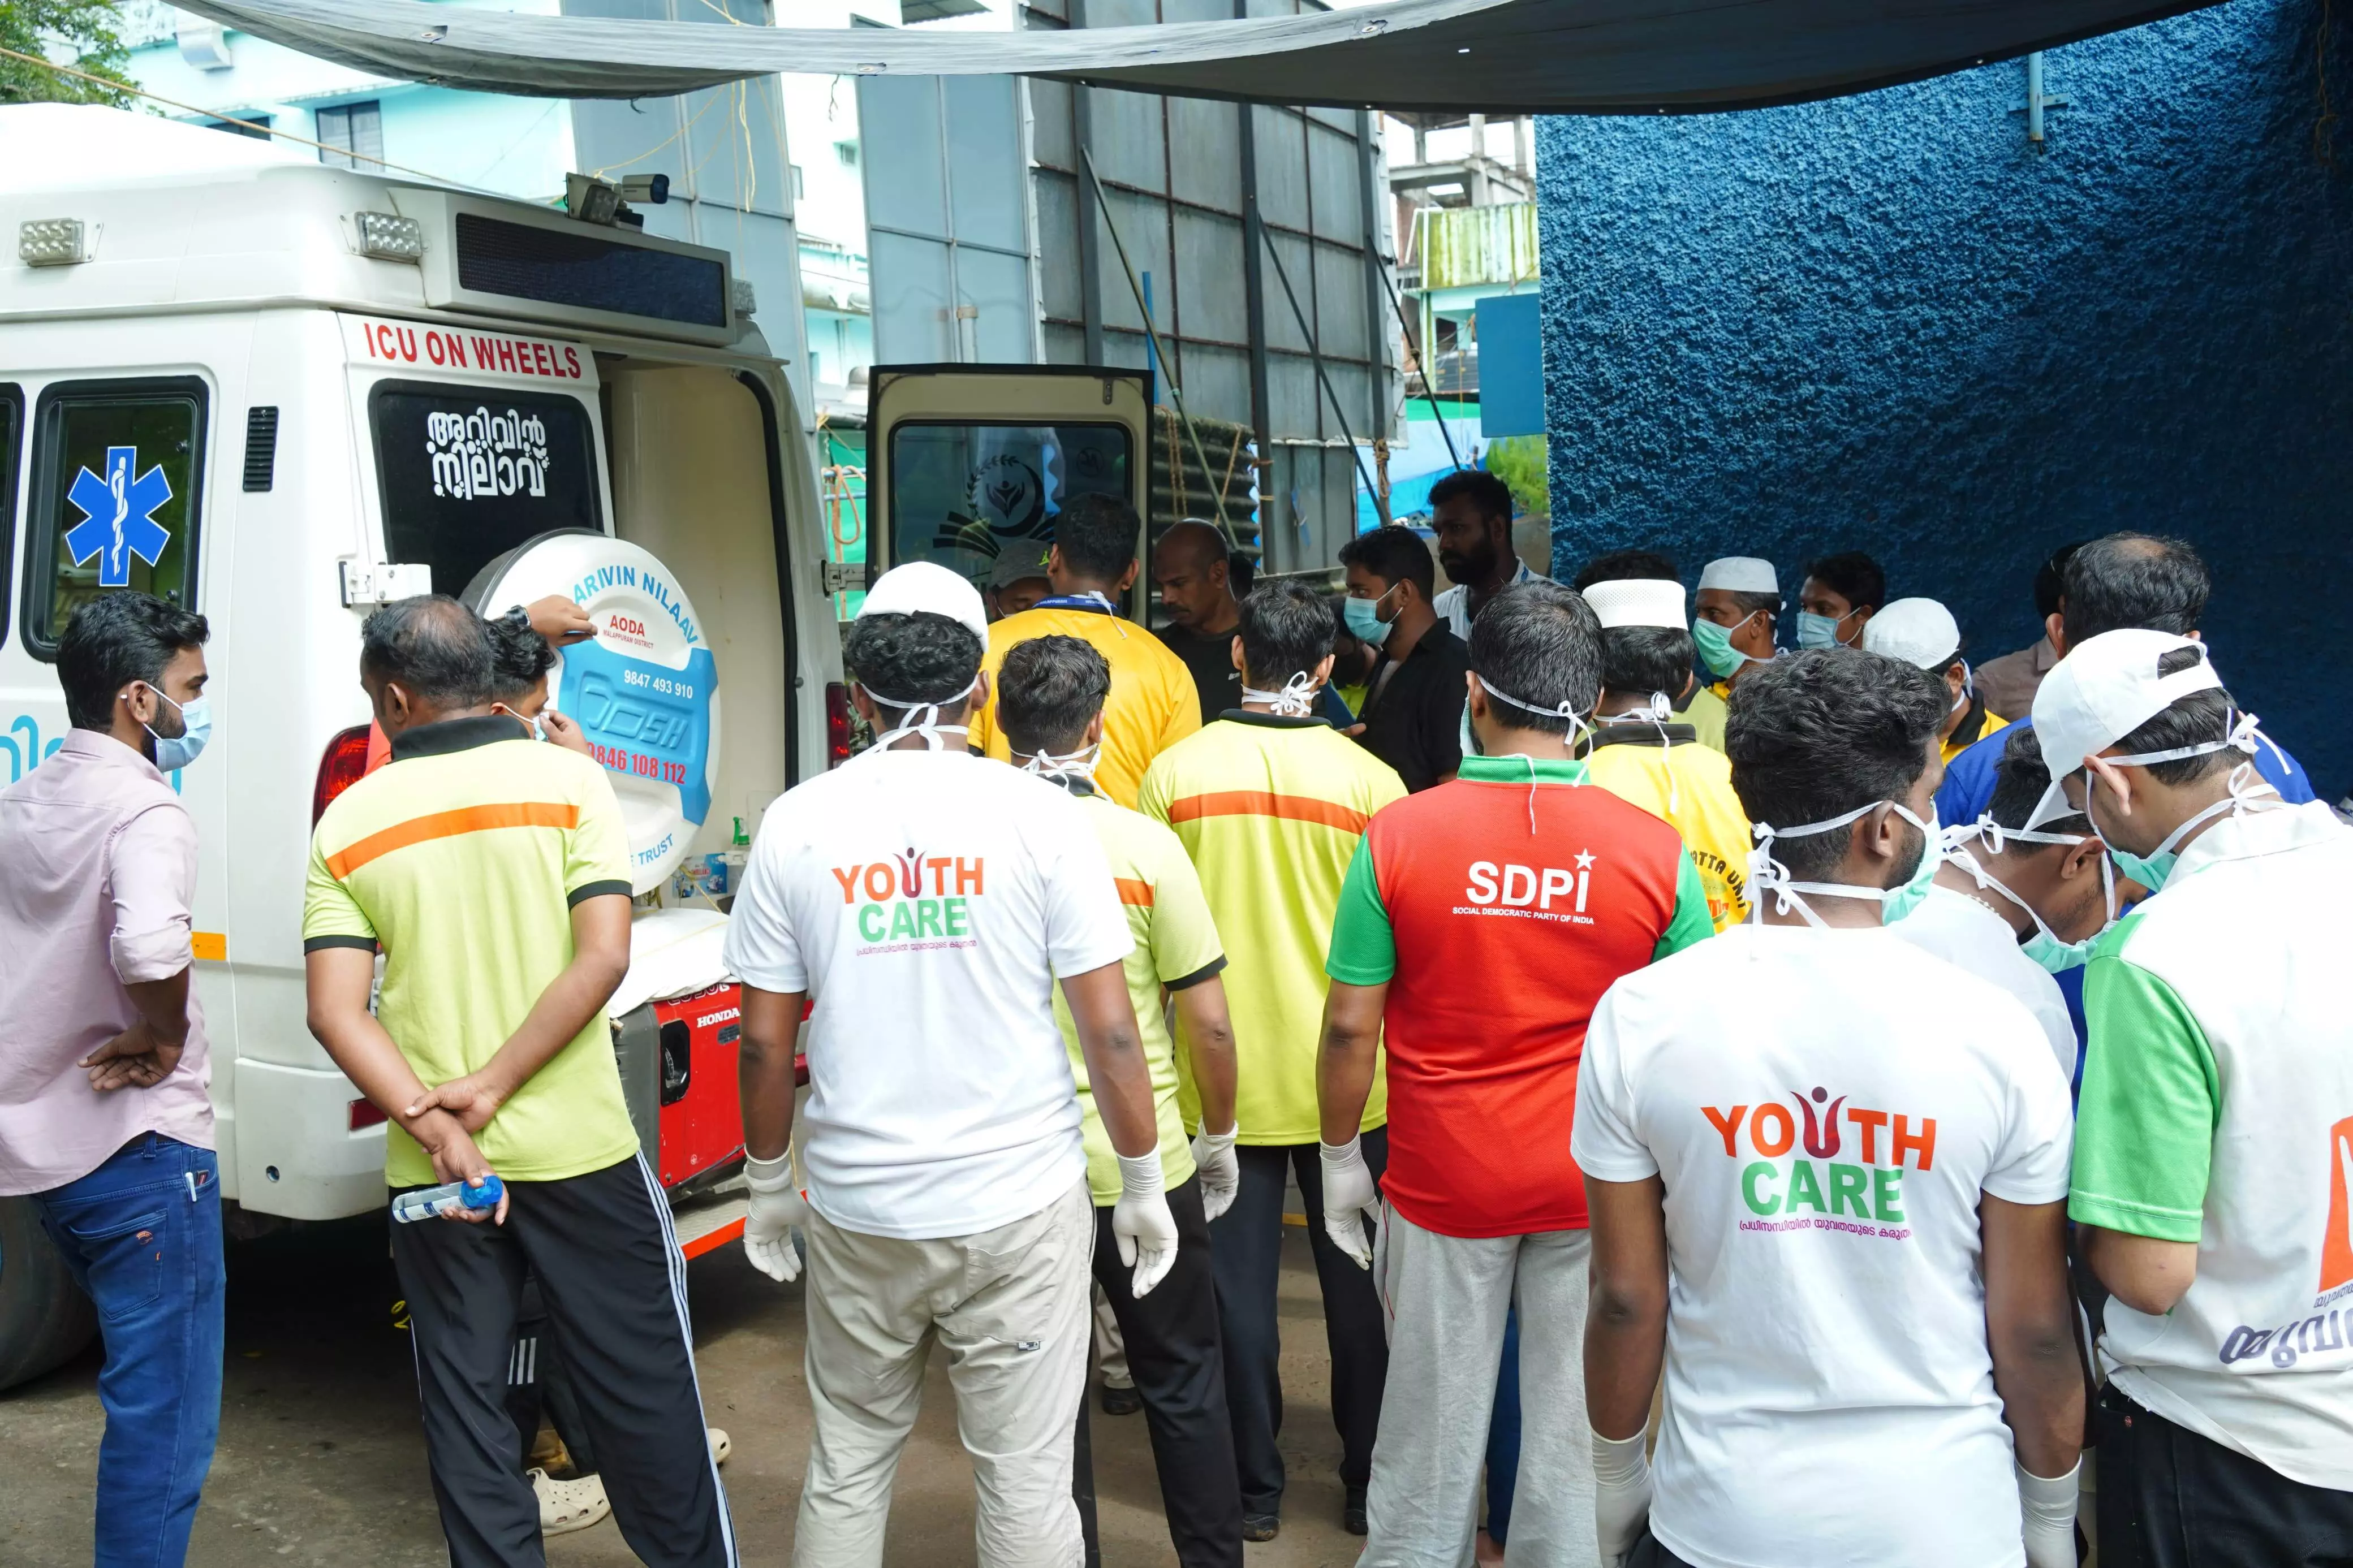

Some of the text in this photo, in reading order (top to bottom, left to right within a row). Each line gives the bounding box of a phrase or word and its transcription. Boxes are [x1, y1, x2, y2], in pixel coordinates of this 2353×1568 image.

[364, 322, 581, 379] ICU ON WHEELS
[573, 565, 698, 644] ARIVIN NILAAV
[604, 629, 654, 649] MALAPPURAM DISTRICT
[610, 615, 645, 637] AODA
[624, 669, 693, 699] 9847 493 910
[631, 754, 658, 777] 108
[663, 761, 686, 784] 112
[638, 833, 673, 865] TRUST
[1690, 850, 1726, 875] ATTA
[831, 848, 983, 904] YOUTH
[859, 898, 967, 942] CARE
[1452, 906, 1480, 915] SOCIAL
[1482, 908, 1532, 918] DEMOCRATIC
[1533, 912, 1558, 921] PARTY
[1572, 916, 1594, 925] INDIA
[696, 1007, 740, 1028] HONDA
[1700, 1086, 1936, 1171] YOUTH
[1742, 1159, 1905, 1223] CARE
